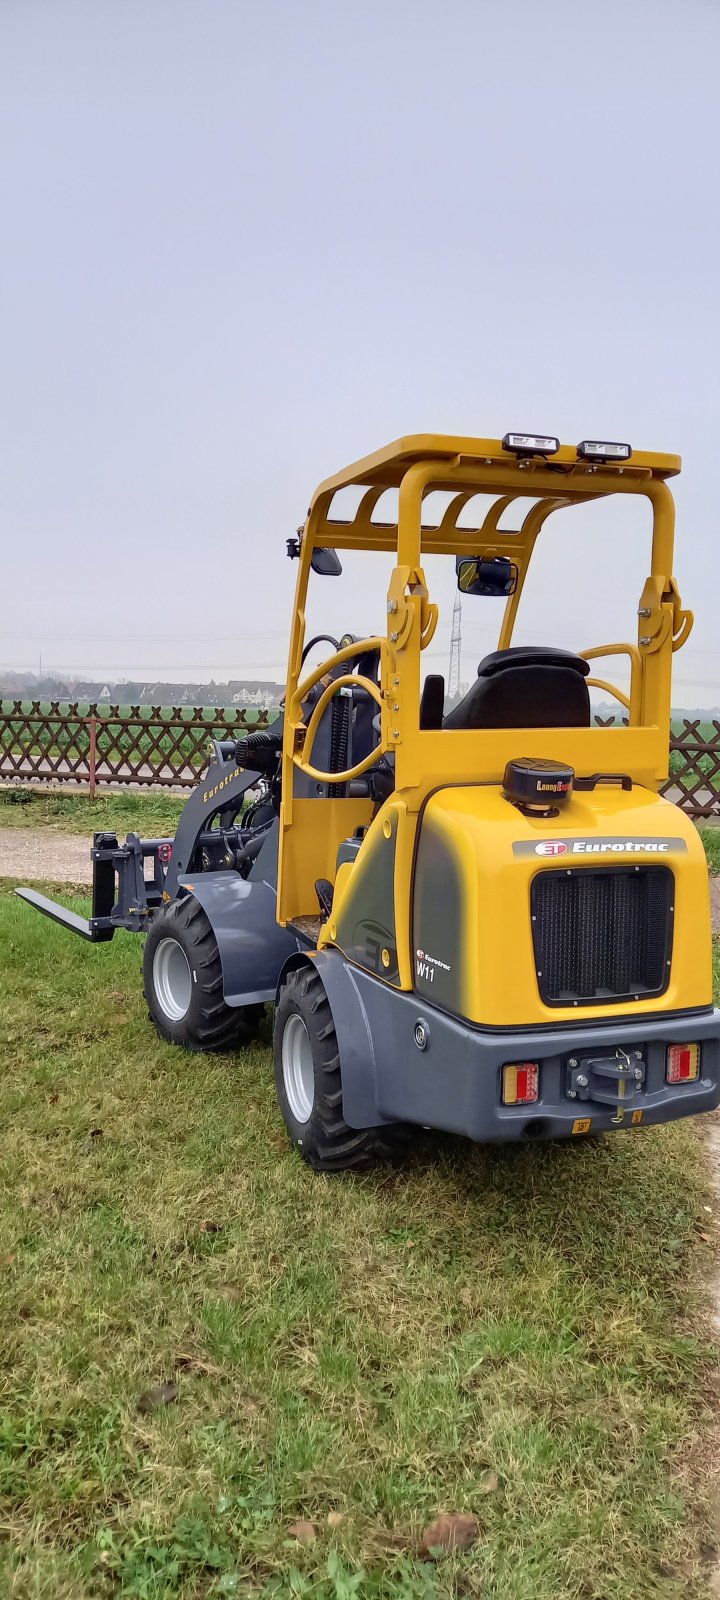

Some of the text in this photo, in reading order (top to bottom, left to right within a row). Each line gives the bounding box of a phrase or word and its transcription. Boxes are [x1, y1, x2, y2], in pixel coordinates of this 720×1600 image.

[540, 841, 669, 856] ET Eurotrac
[424, 953, 452, 971] Eurotrac
[416, 960, 434, 983] W11
